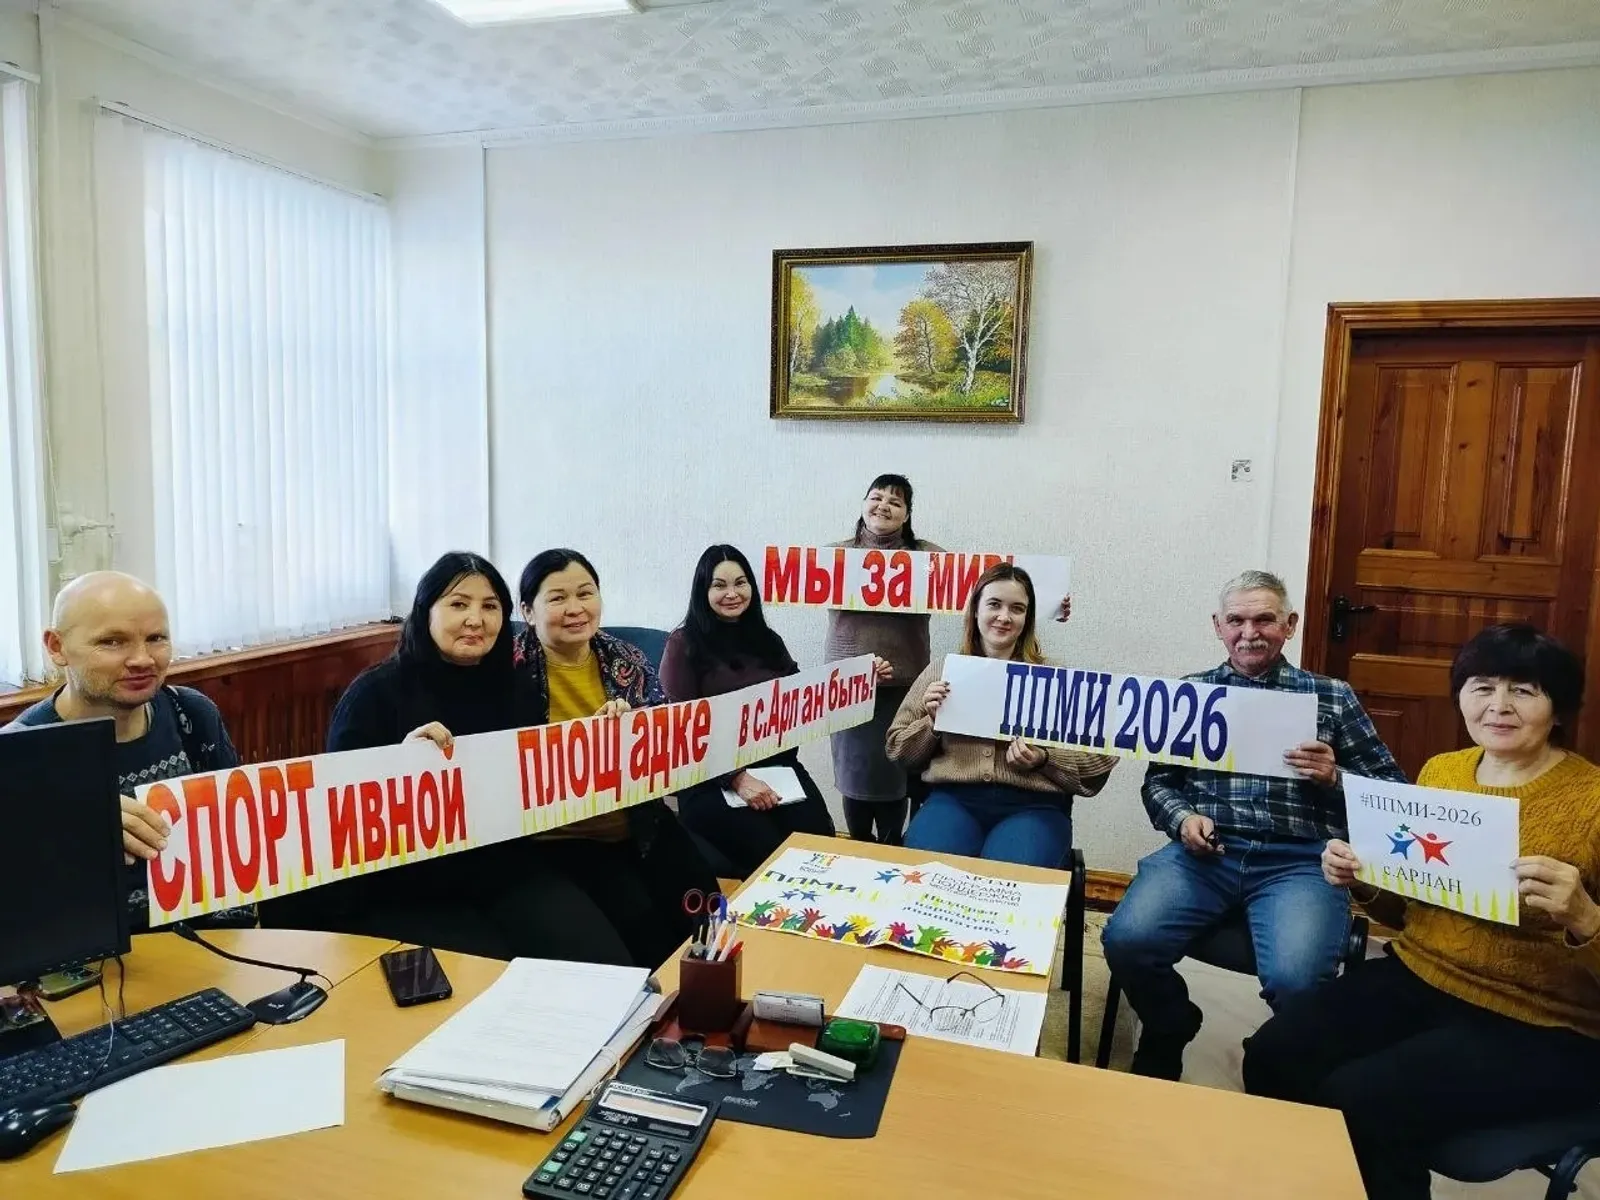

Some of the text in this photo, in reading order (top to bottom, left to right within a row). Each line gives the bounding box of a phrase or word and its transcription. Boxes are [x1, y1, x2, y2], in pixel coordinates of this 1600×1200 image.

[1000, 664, 1228, 763] ППМИ 2026
[1360, 791, 1482, 827] #ППМИ-2026
[764, 870, 857, 893] ППМИ
